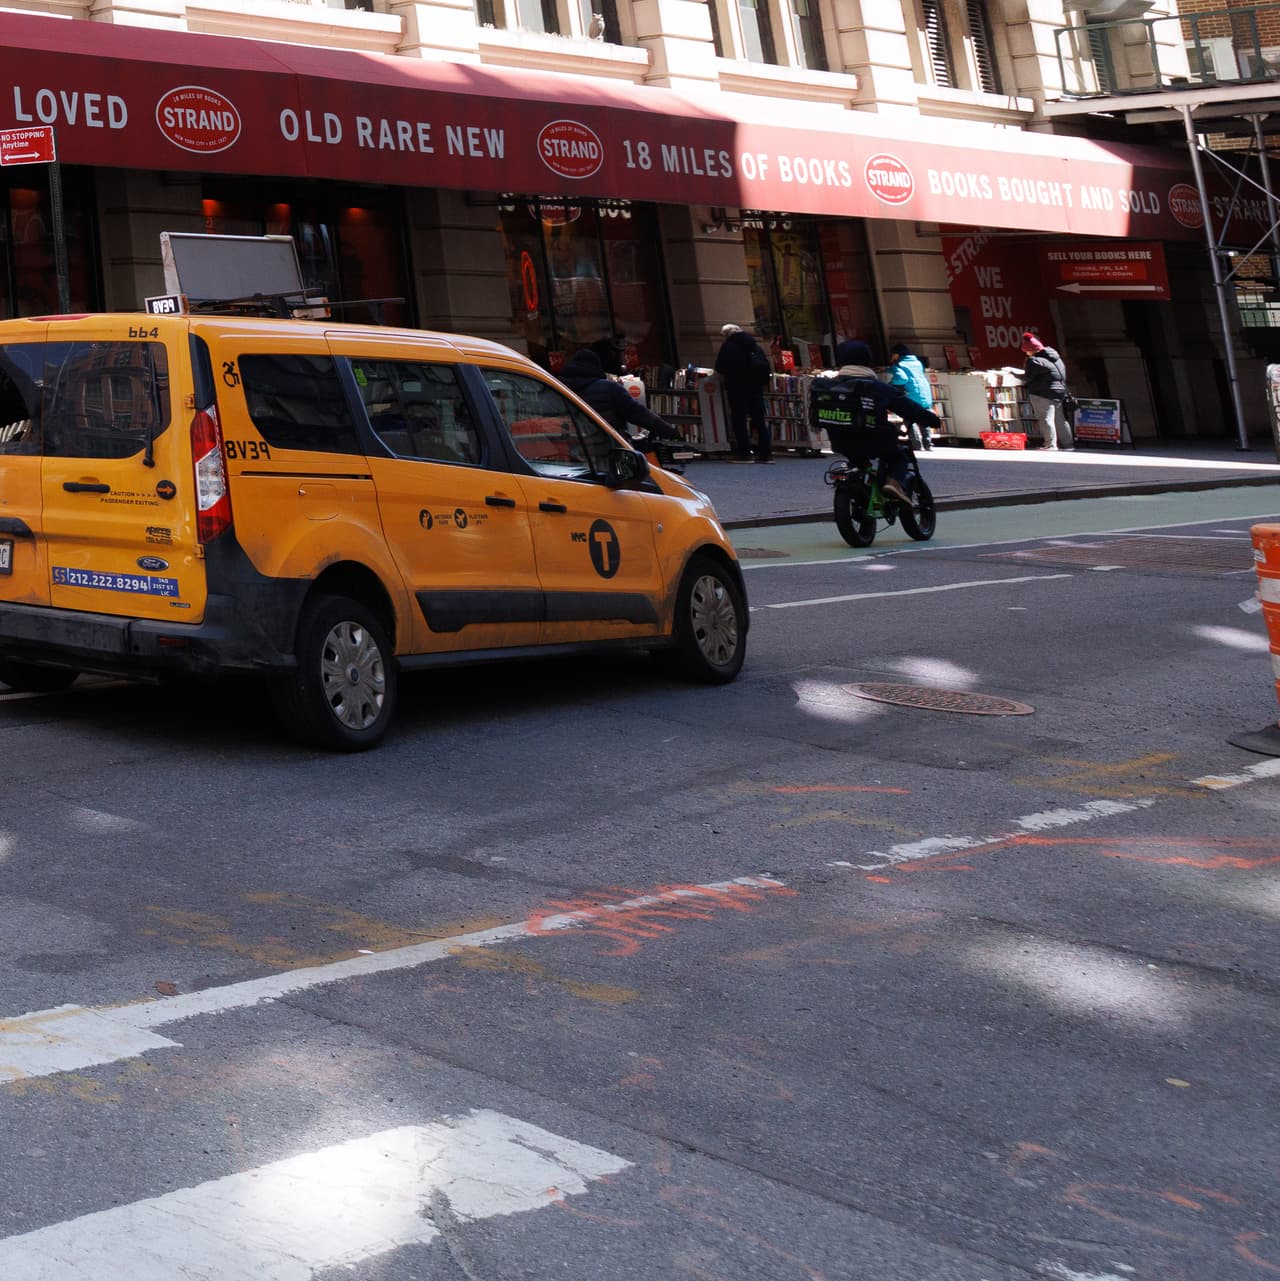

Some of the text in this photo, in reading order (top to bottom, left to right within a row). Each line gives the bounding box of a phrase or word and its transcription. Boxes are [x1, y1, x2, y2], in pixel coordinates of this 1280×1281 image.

[14, 86, 129, 129] LOVED
[163, 107, 235, 132] STRAND
[12, 131, 45, 140] STOPPING
[279, 108, 505, 159] OLD RARE NEW
[2, 141, 29, 149] Anytime
[543, 138, 598, 159] STRAND
[623, 140, 853, 188] 18 MILES OF BOOKS
[868, 169, 910, 188] STRAND
[927, 169, 1161, 215] BOOKS BOUGHT AND SOLD
[1172, 198, 1201, 213] STRAN
[1048, 251, 1152, 260] SELL YOUR BOOKS HERE
[974, 266, 1004, 288] WE
[153, 299, 175, 313] 8V39
[980, 296, 1012, 318] BUY
[985, 325, 1039, 348] BOO
[226, 441, 271, 459] 8V39
[571, 533, 587, 542] NYC
[594, 531, 612, 572] T
[69, 572, 148, 591] 212.222.8294
